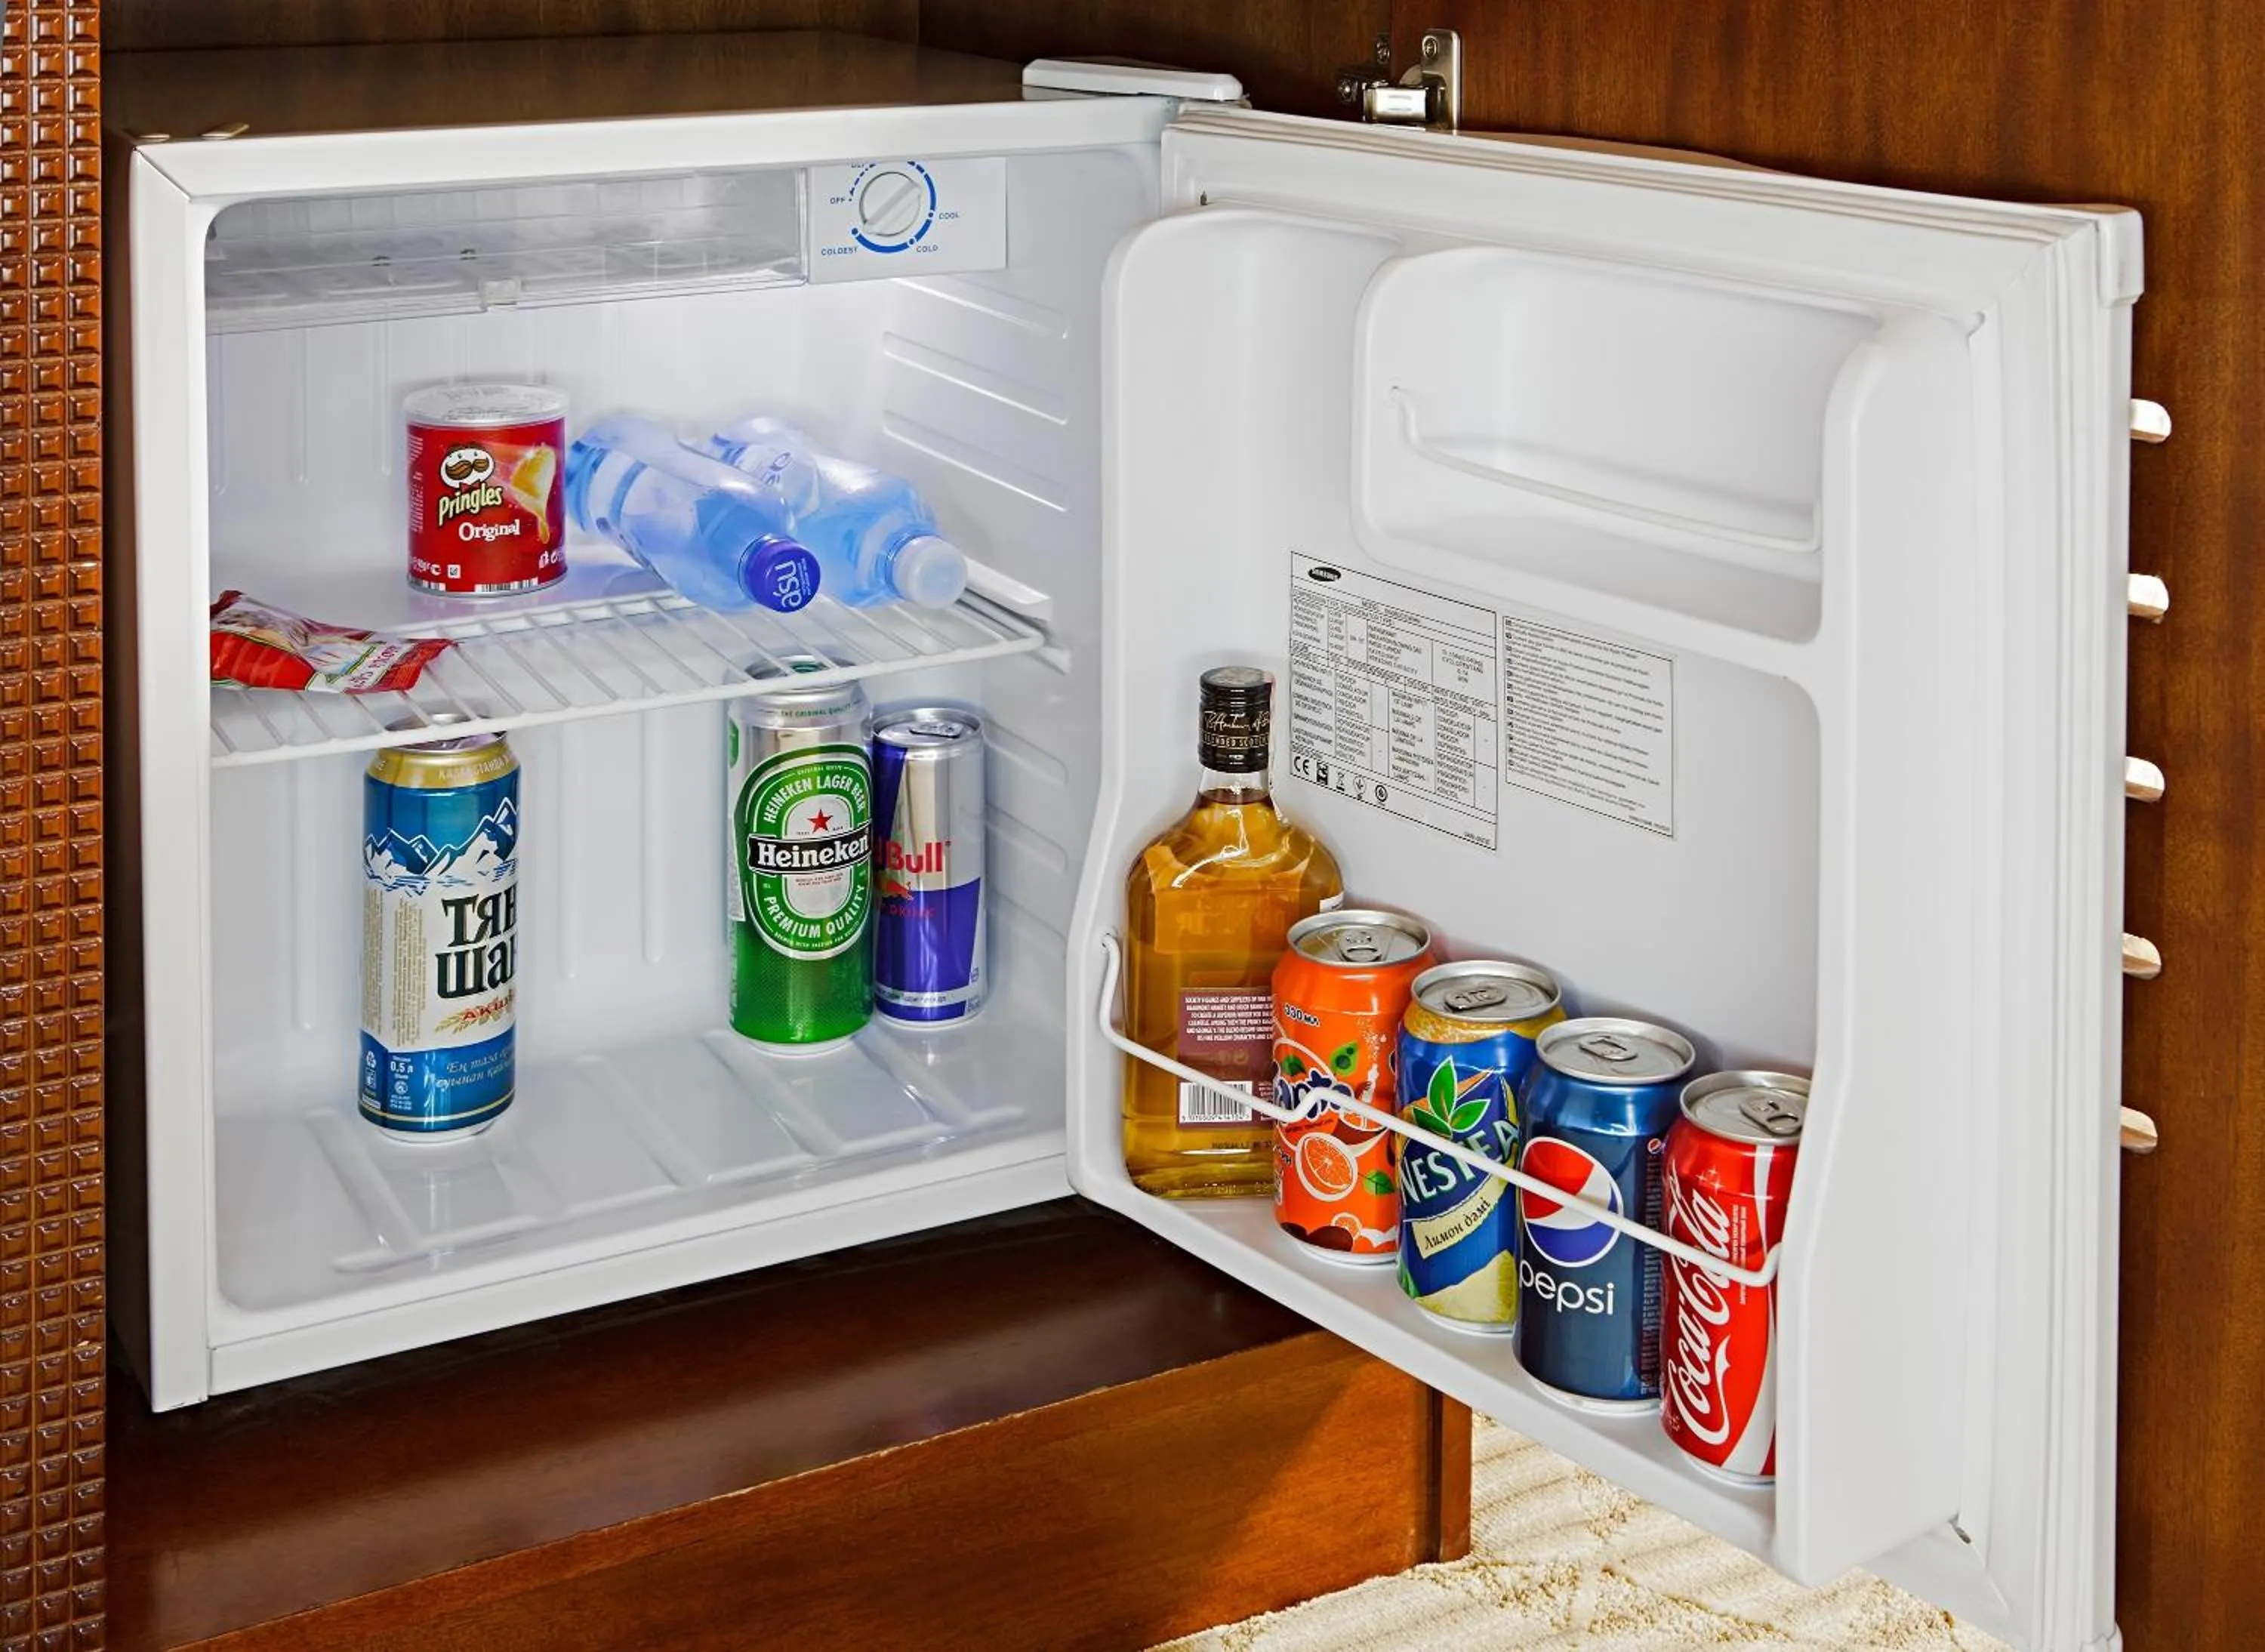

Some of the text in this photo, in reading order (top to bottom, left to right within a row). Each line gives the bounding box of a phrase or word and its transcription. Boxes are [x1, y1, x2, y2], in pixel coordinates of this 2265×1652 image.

[938, 212, 960, 220] COOL
[821, 247, 858, 256] COLDEST
[916, 245, 938, 254] COLD
[437, 483, 503, 526] Pringles
[458, 519, 520, 541] Original
[795, 709, 827, 717] ORIGINAL
[763, 775, 867, 824] HEINEKEN LAGER BEER
[757, 834, 868, 868] Heineken
[886, 842, 942, 874] Bull
[763, 884, 864, 938] PREMIUM QUALITY
[1284, 1003, 1302, 1020] 330
[390, 1062, 405, 1072] 0.5
[1401, 1119, 1519, 1206] NESTEA
[1424, 1225, 1464, 1250] Лимон
[1518, 1257, 1615, 1315] pepsi
[1668, 1160, 1730, 1444] Coca-Cola
